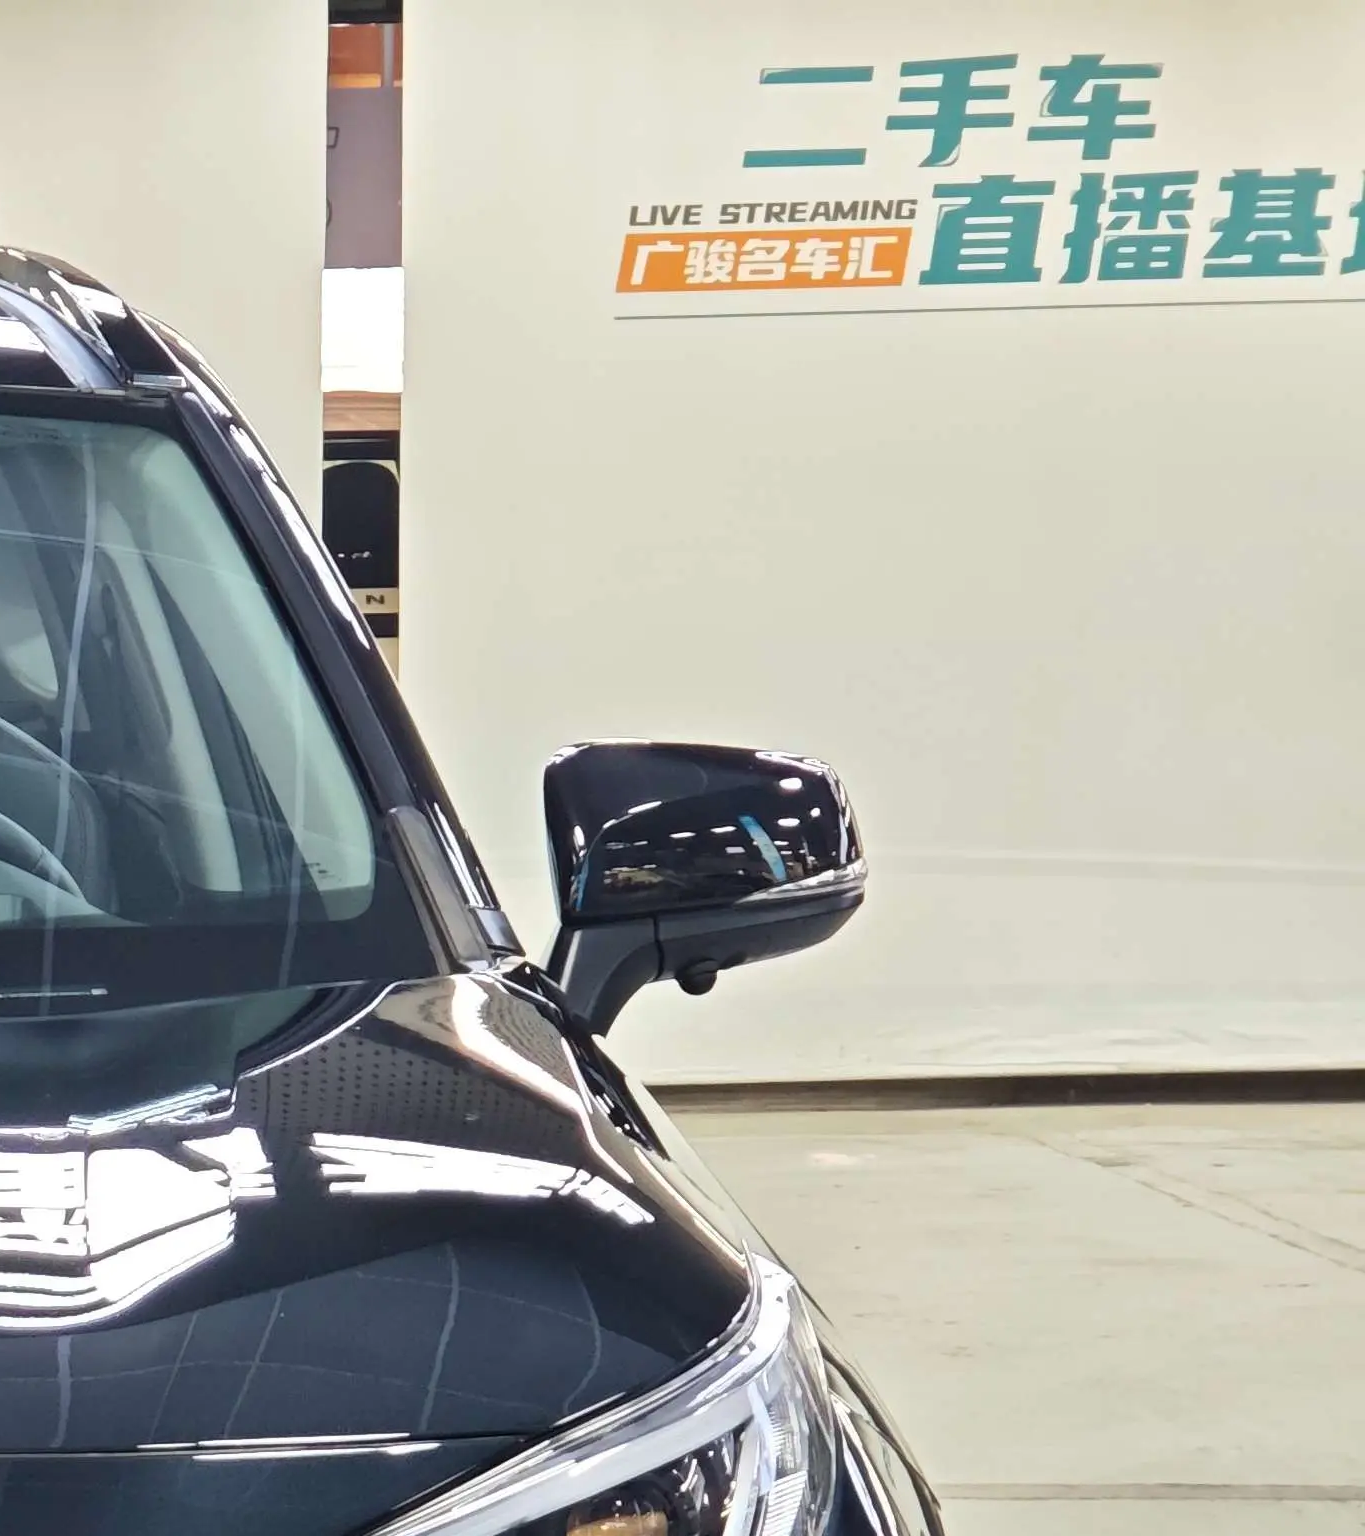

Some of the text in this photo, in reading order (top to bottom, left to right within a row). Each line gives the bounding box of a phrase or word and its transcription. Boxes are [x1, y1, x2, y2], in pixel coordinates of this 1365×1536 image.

[743, 54, 1163, 168] 二手车
[629, 198, 918, 227] LIVE STREAMING
[919, 168, 1365, 285] 直播基
[630, 234, 900, 286] 广骏名车汇
